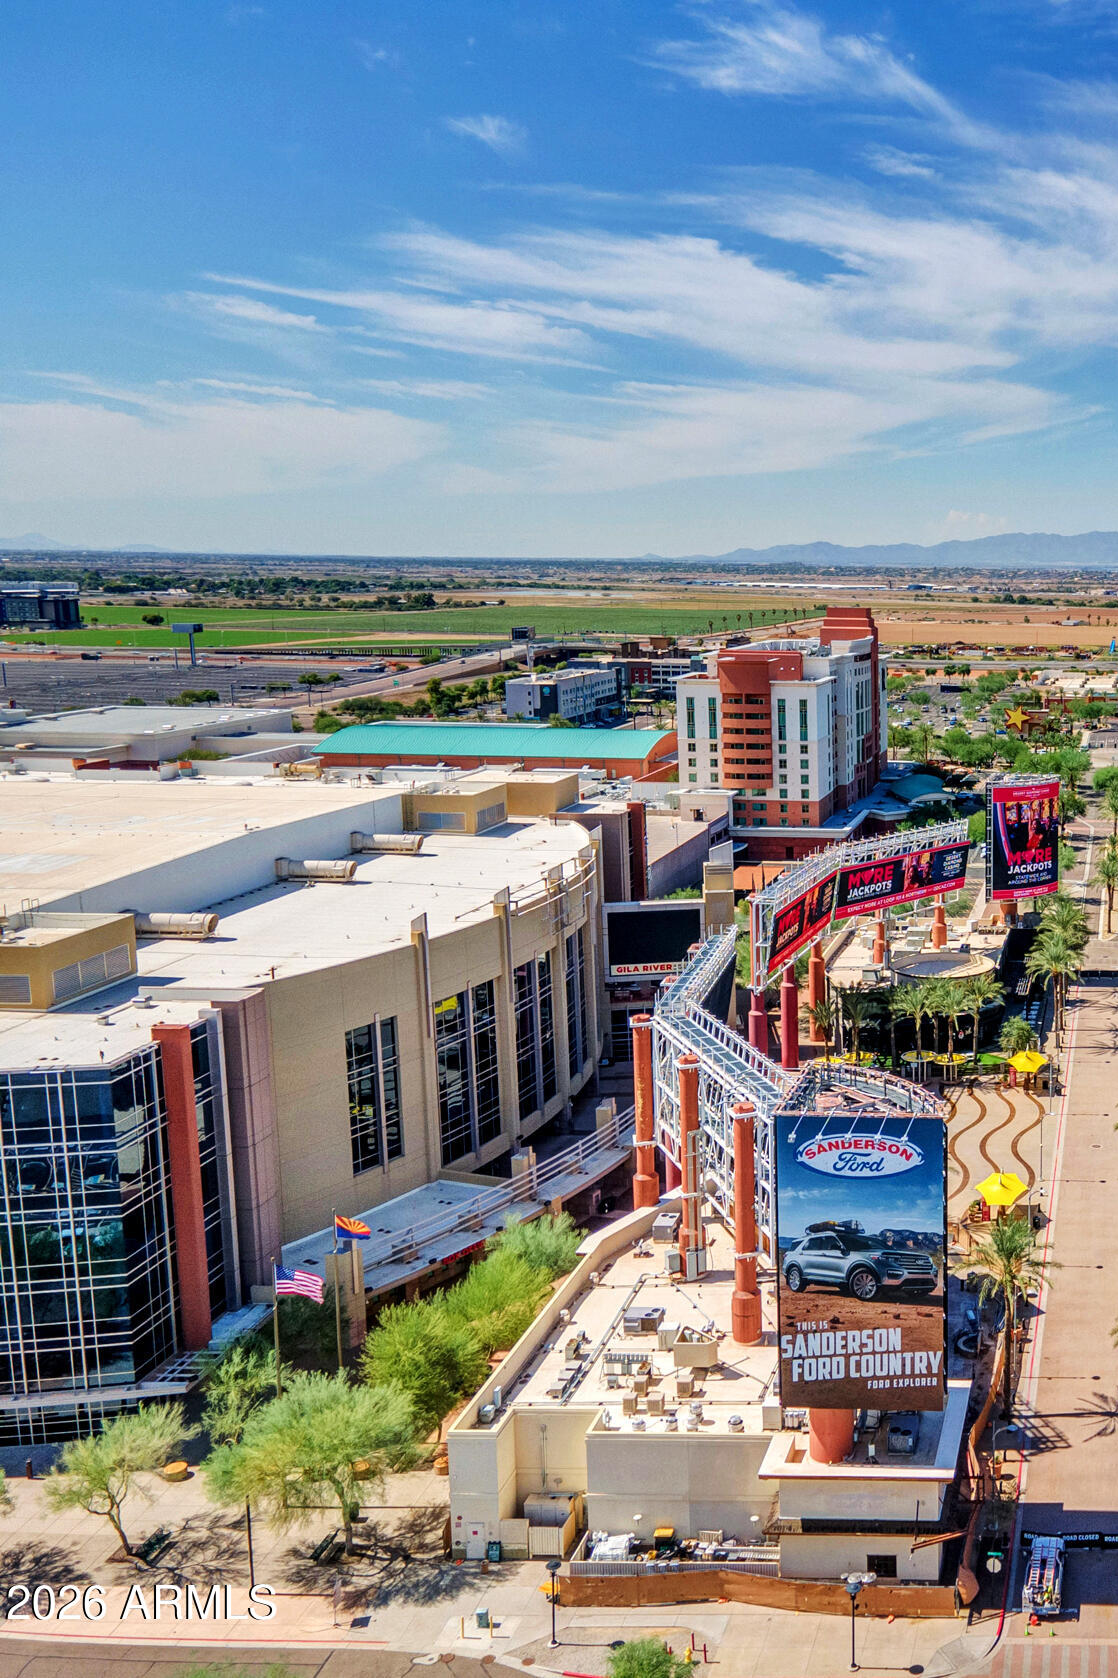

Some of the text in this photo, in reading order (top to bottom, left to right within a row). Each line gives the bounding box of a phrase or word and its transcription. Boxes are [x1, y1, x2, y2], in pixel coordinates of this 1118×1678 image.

[1007, 860, 1052, 874] JACKPOTS
[847, 880, 893, 898] JACKPOTS
[616, 965, 640, 973] GILA
[642, 963, 673, 972] RIVER
[804, 1138, 914, 1162] SANDERSON
[833, 1151, 884, 1173] Ford
[796, 1321, 828, 1331] THIS IS
[781, 1327, 902, 1359] SANDERSON
[792, 1350, 943, 1382] FORD COUNTRY
[867, 1377, 938, 1389] FORD EXPLORER
